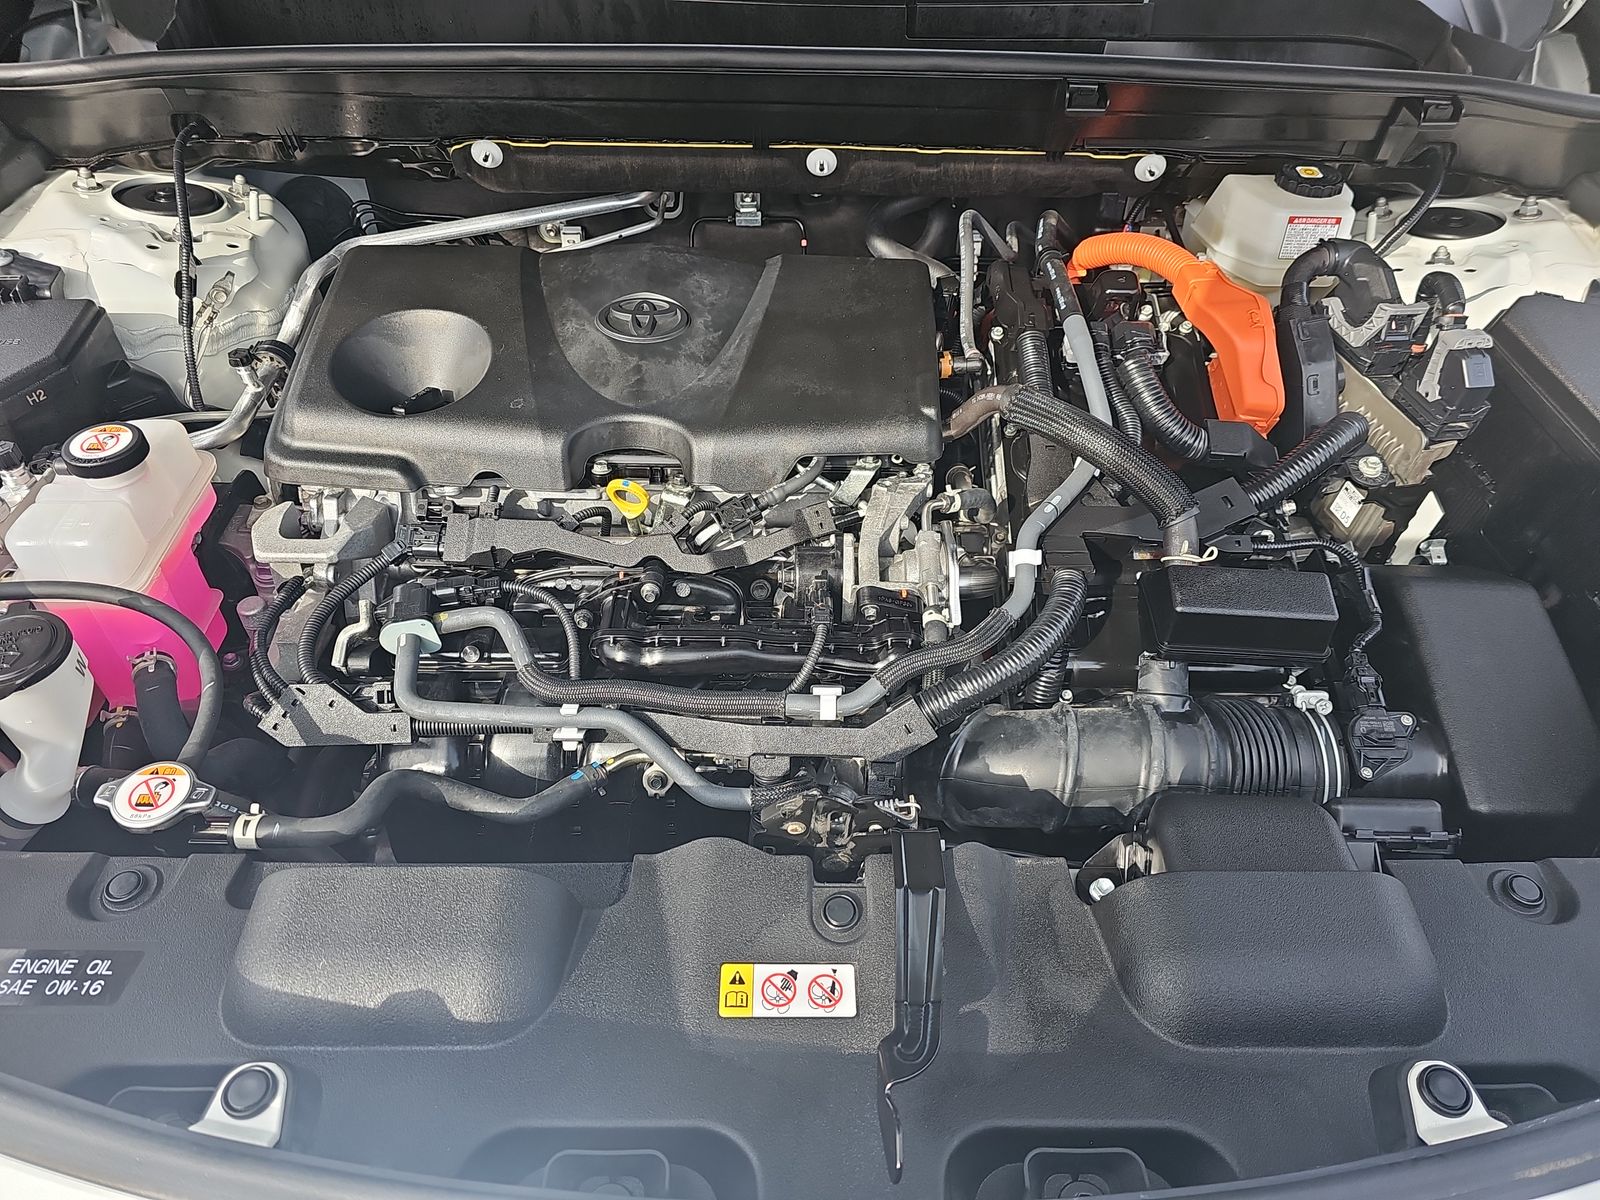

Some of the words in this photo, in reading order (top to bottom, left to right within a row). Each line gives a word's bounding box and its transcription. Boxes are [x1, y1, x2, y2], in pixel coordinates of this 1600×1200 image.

[26, 389, 47, 406] H2
[8, 959, 79, 975] ENGINE
[86, 959, 113, 975] OIL
[0, 979, 37, 995] SAE
